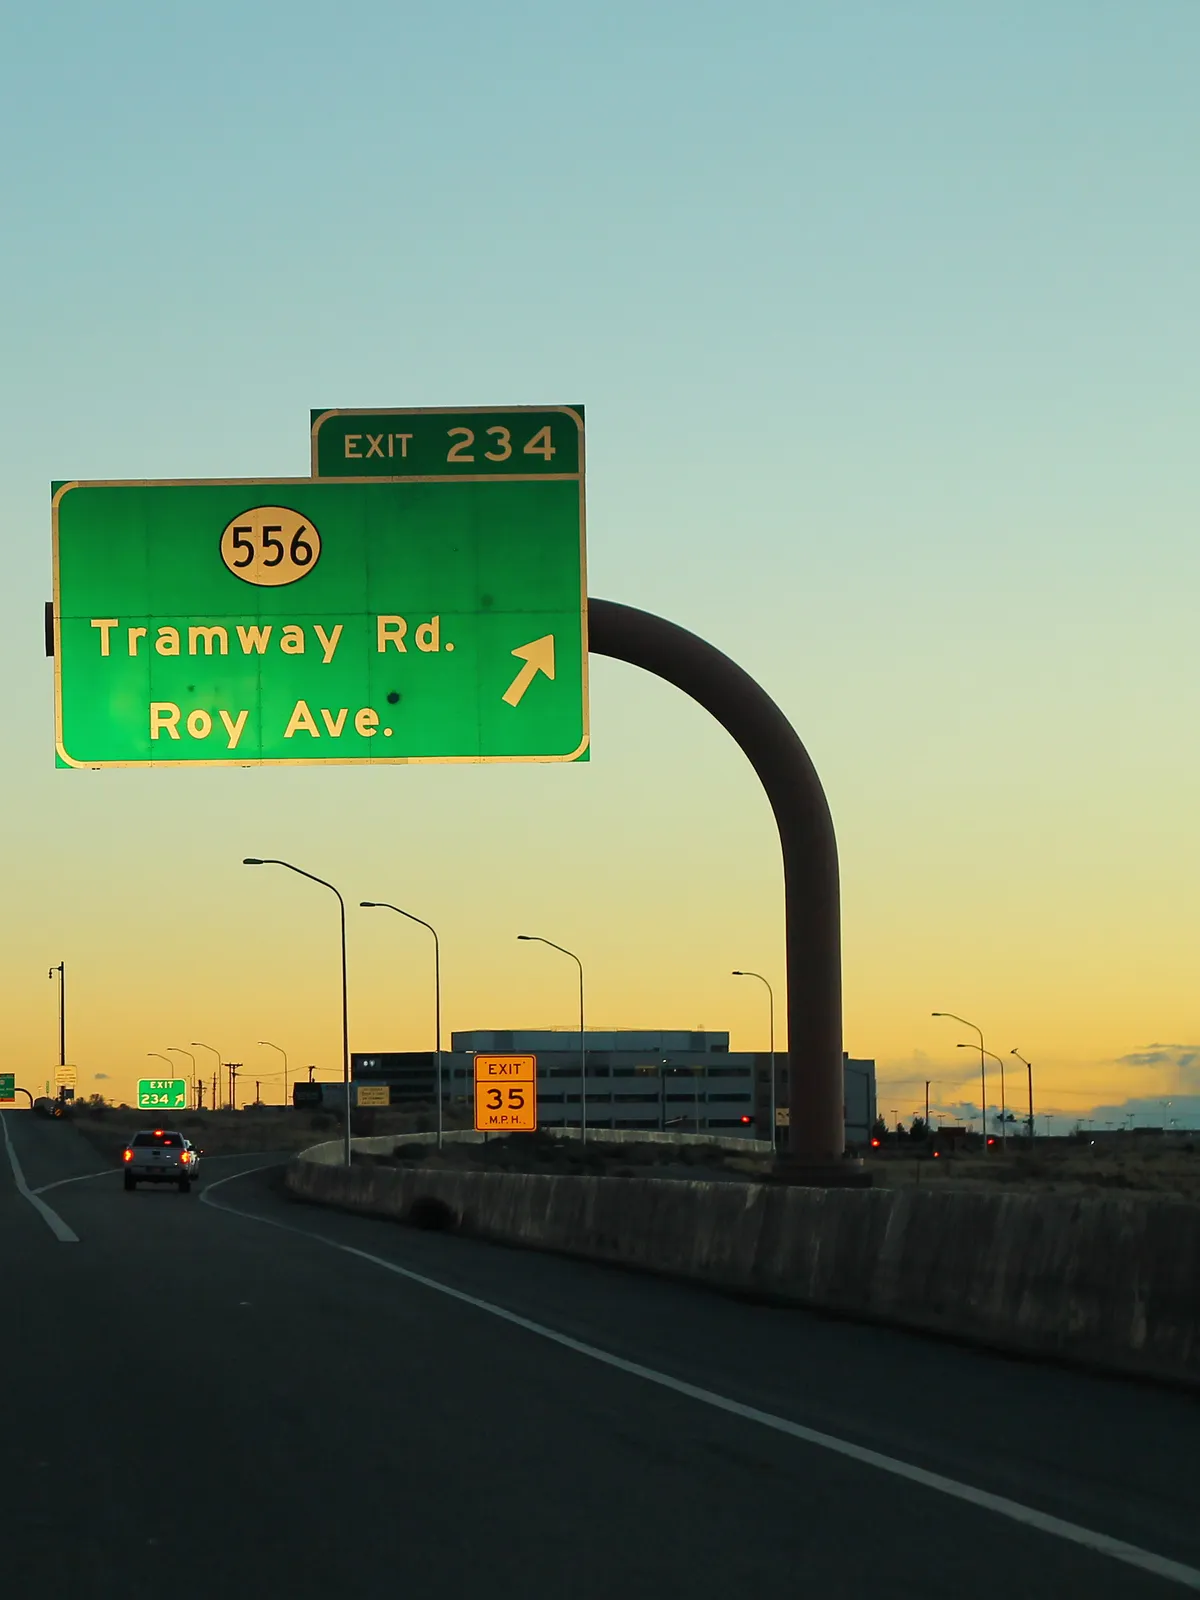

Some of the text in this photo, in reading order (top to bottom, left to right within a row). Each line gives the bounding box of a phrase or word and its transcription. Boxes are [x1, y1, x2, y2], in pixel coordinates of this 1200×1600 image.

[344, 426, 556, 463] EXIT 234
[232, 525, 313, 568] 556
[90, 615, 456, 664] Tramway Rd.
[150, 699, 394, 750] Roy Ave.
[488, 1063, 522, 1075] EXIT
[140, 1093, 169, 1105] 234
[150, 1081, 174, 1089] EXIT
[486, 1088, 525, 1110] 35
